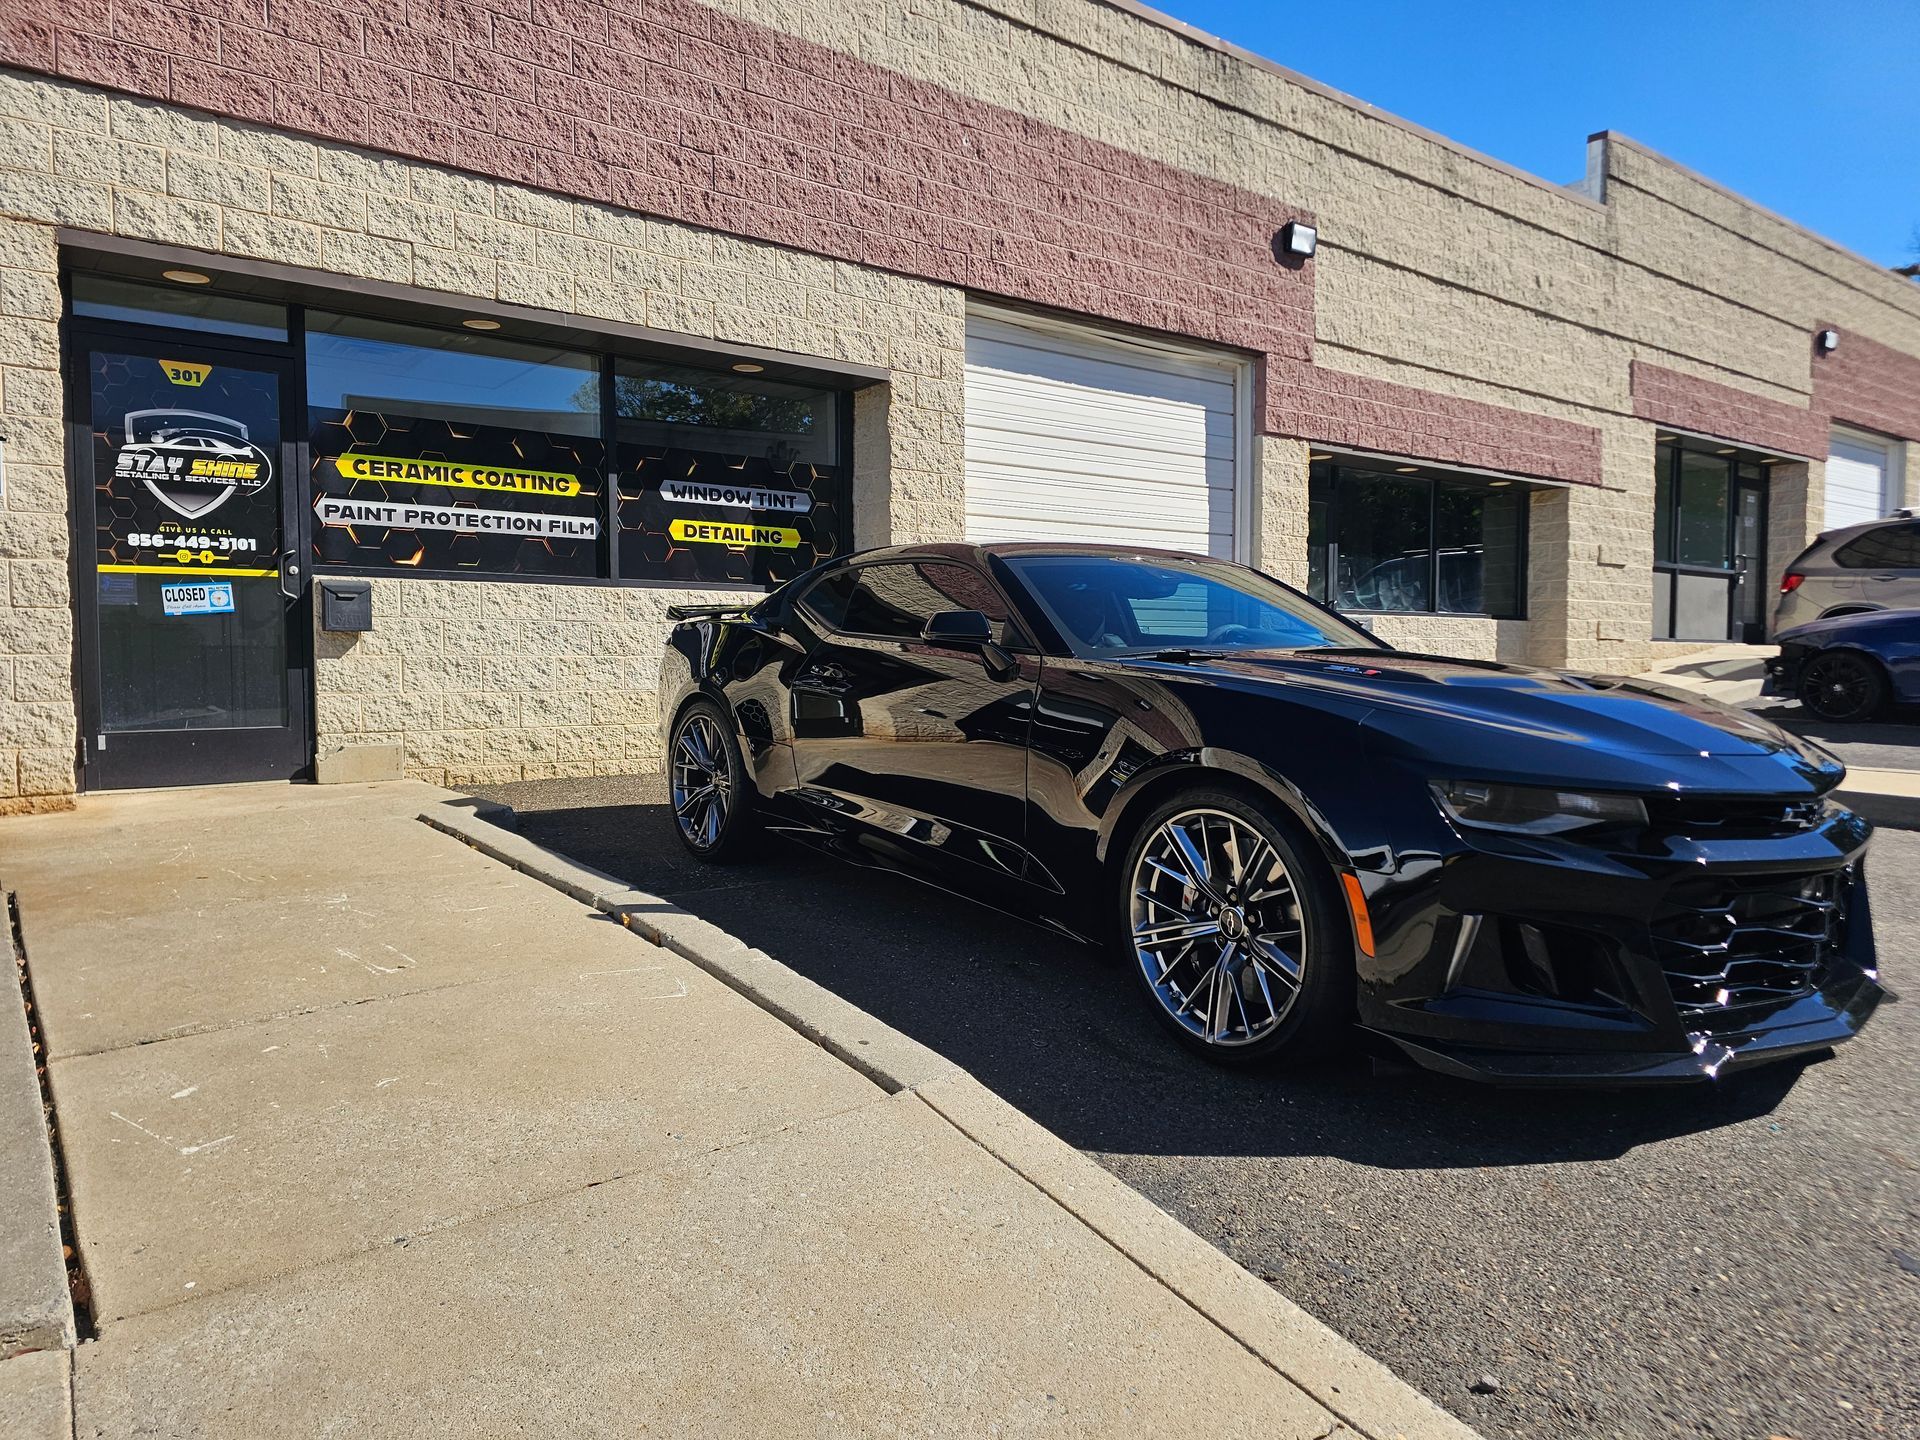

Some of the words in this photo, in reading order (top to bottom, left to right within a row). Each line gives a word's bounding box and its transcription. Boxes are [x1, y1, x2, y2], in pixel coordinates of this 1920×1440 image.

[171, 368, 200, 383] 301
[115, 453, 183, 473] STAY
[190, 459, 260, 479] SHINE
[115, 470, 170, 480] DETAILING
[352, 458, 464, 483] CERAMIC
[471, 469, 570, 492] COATING
[670, 484, 751, 504] WINDOW
[756, 492, 797, 508] TINT
[324, 504, 397, 522] PAINT
[404, 509, 542, 532] PROTECTION
[549, 519, 595, 535] FILM
[127, 533, 256, 551] 856-449-3101
[683, 524, 783, 544] DETAILING
[165, 587, 206, 602] CLOSED
